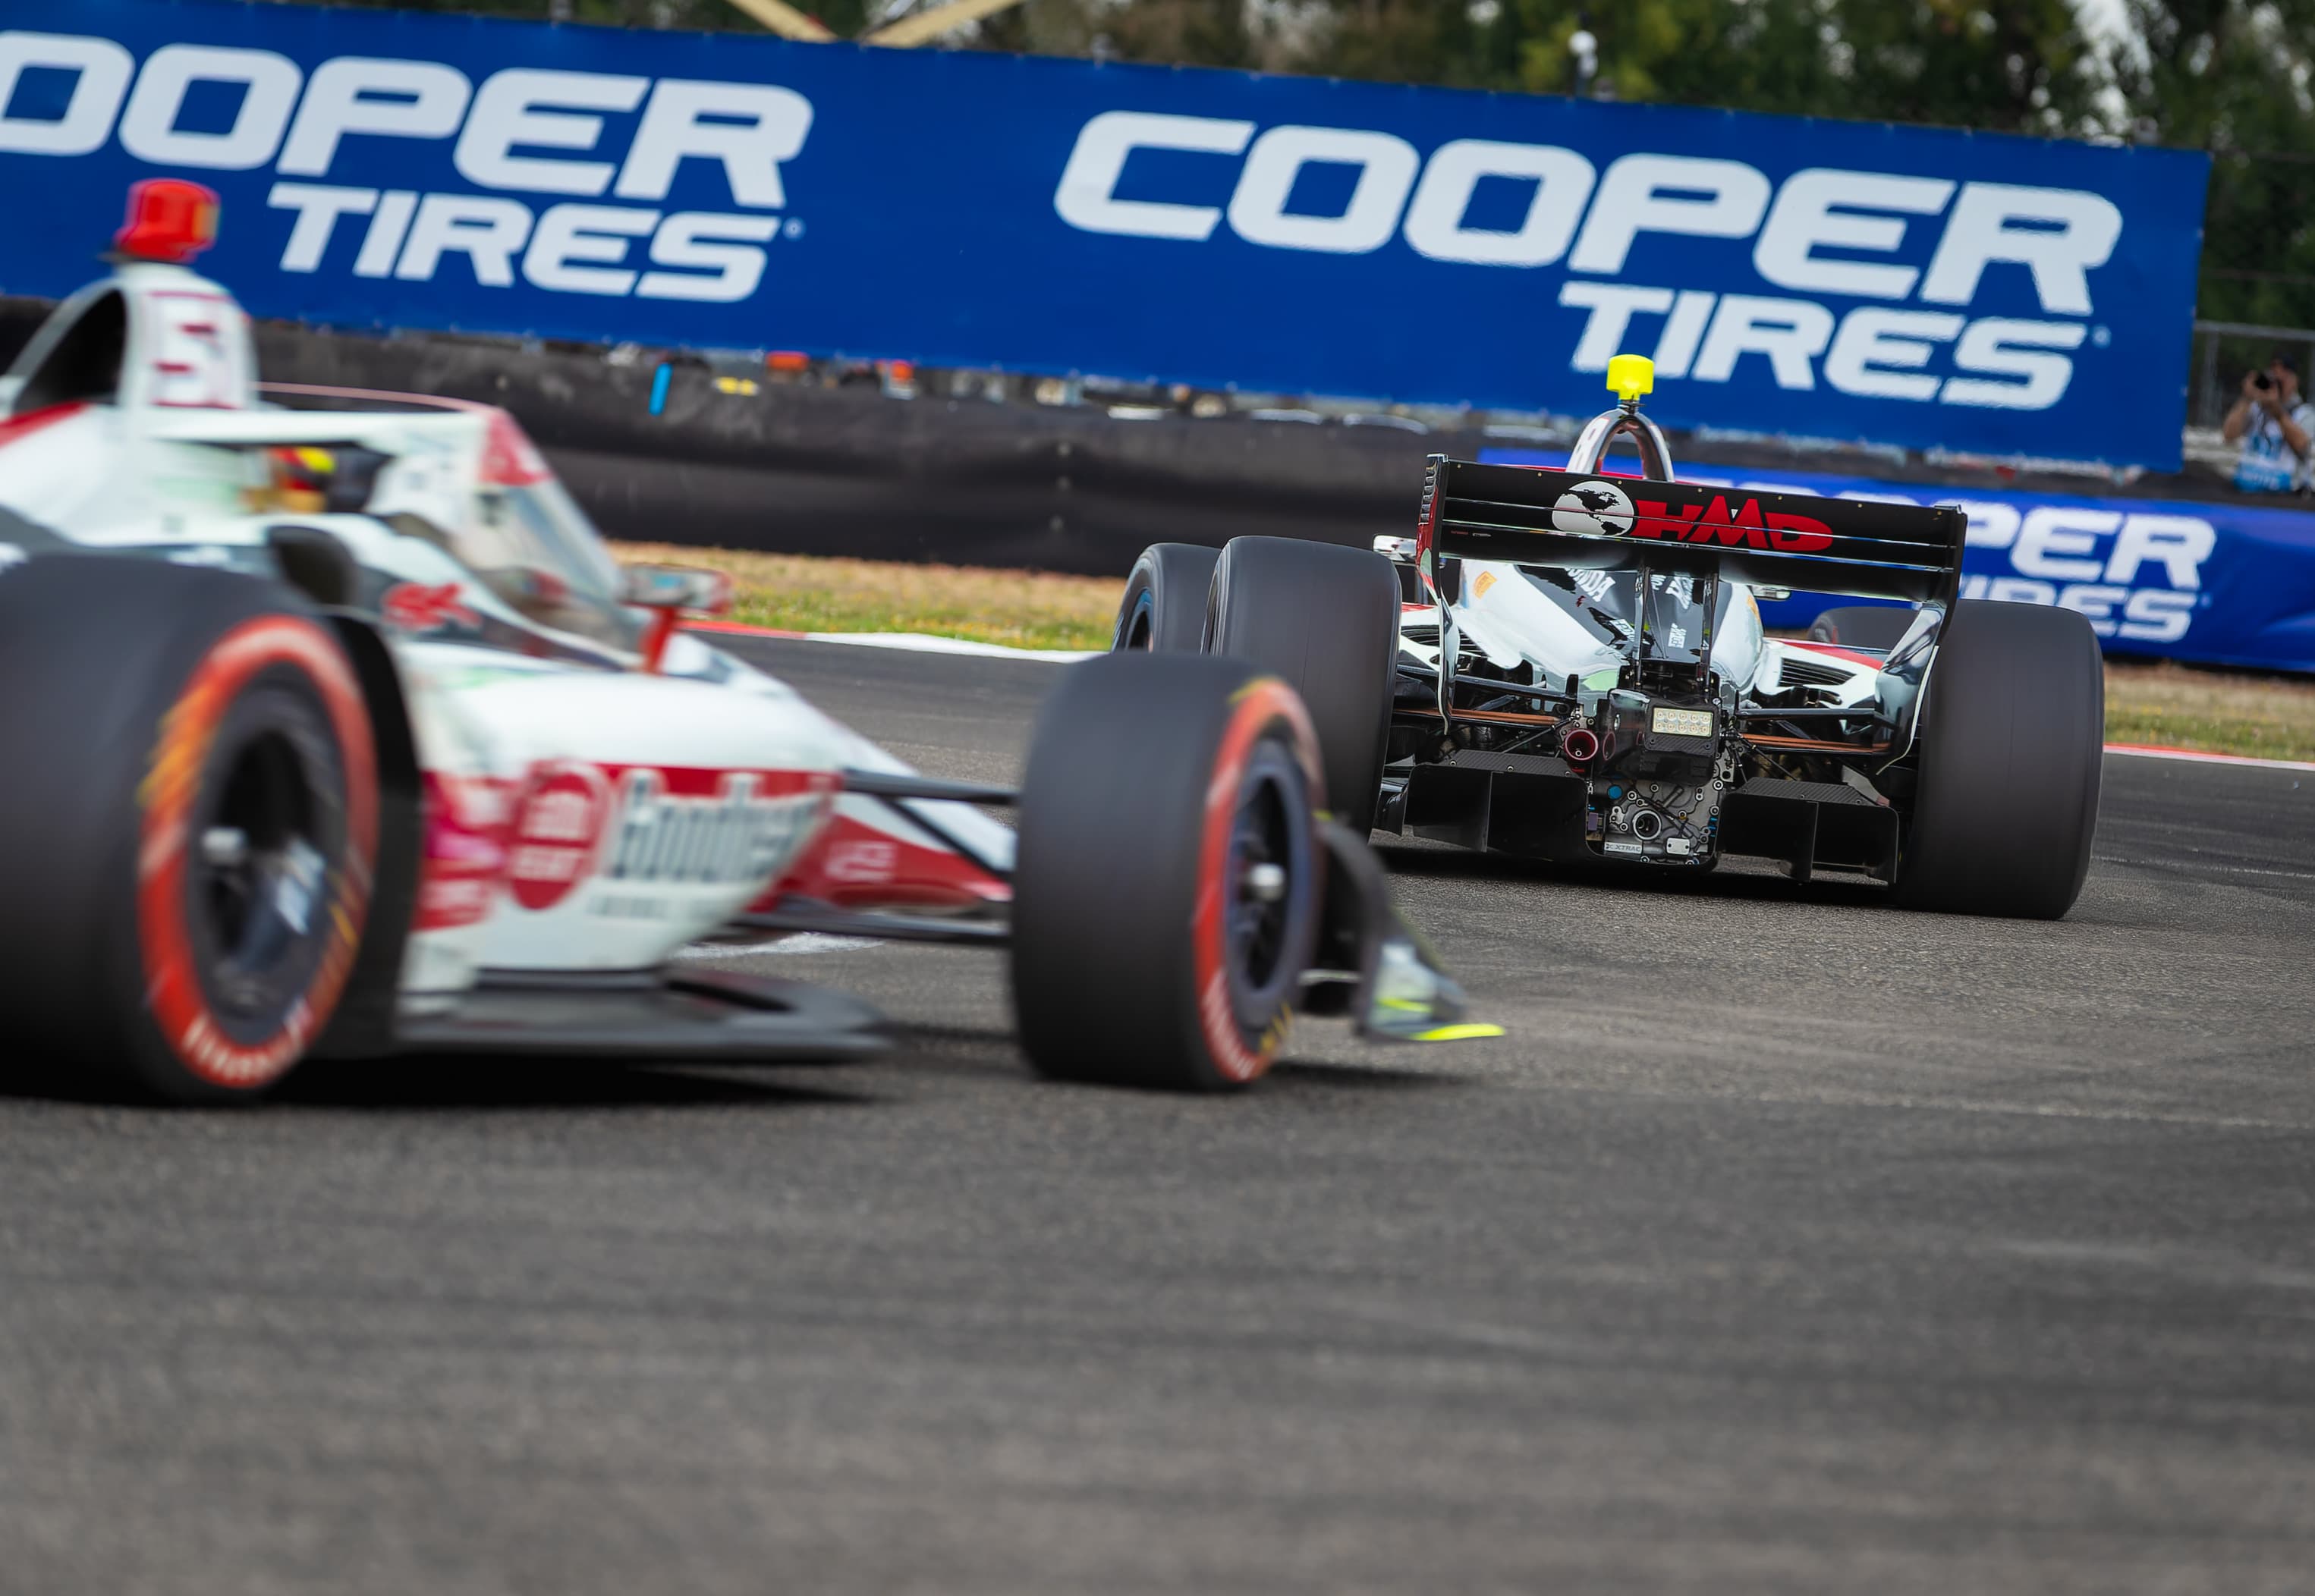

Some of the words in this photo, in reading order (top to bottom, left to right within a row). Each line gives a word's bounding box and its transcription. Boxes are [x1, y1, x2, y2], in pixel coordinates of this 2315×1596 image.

[267, 182, 780, 303] TIRES
[1054, 110, 2123, 316] COOPER
[1558, 281, 2087, 410] TIRES
[1631, 495, 1834, 551] HMD
